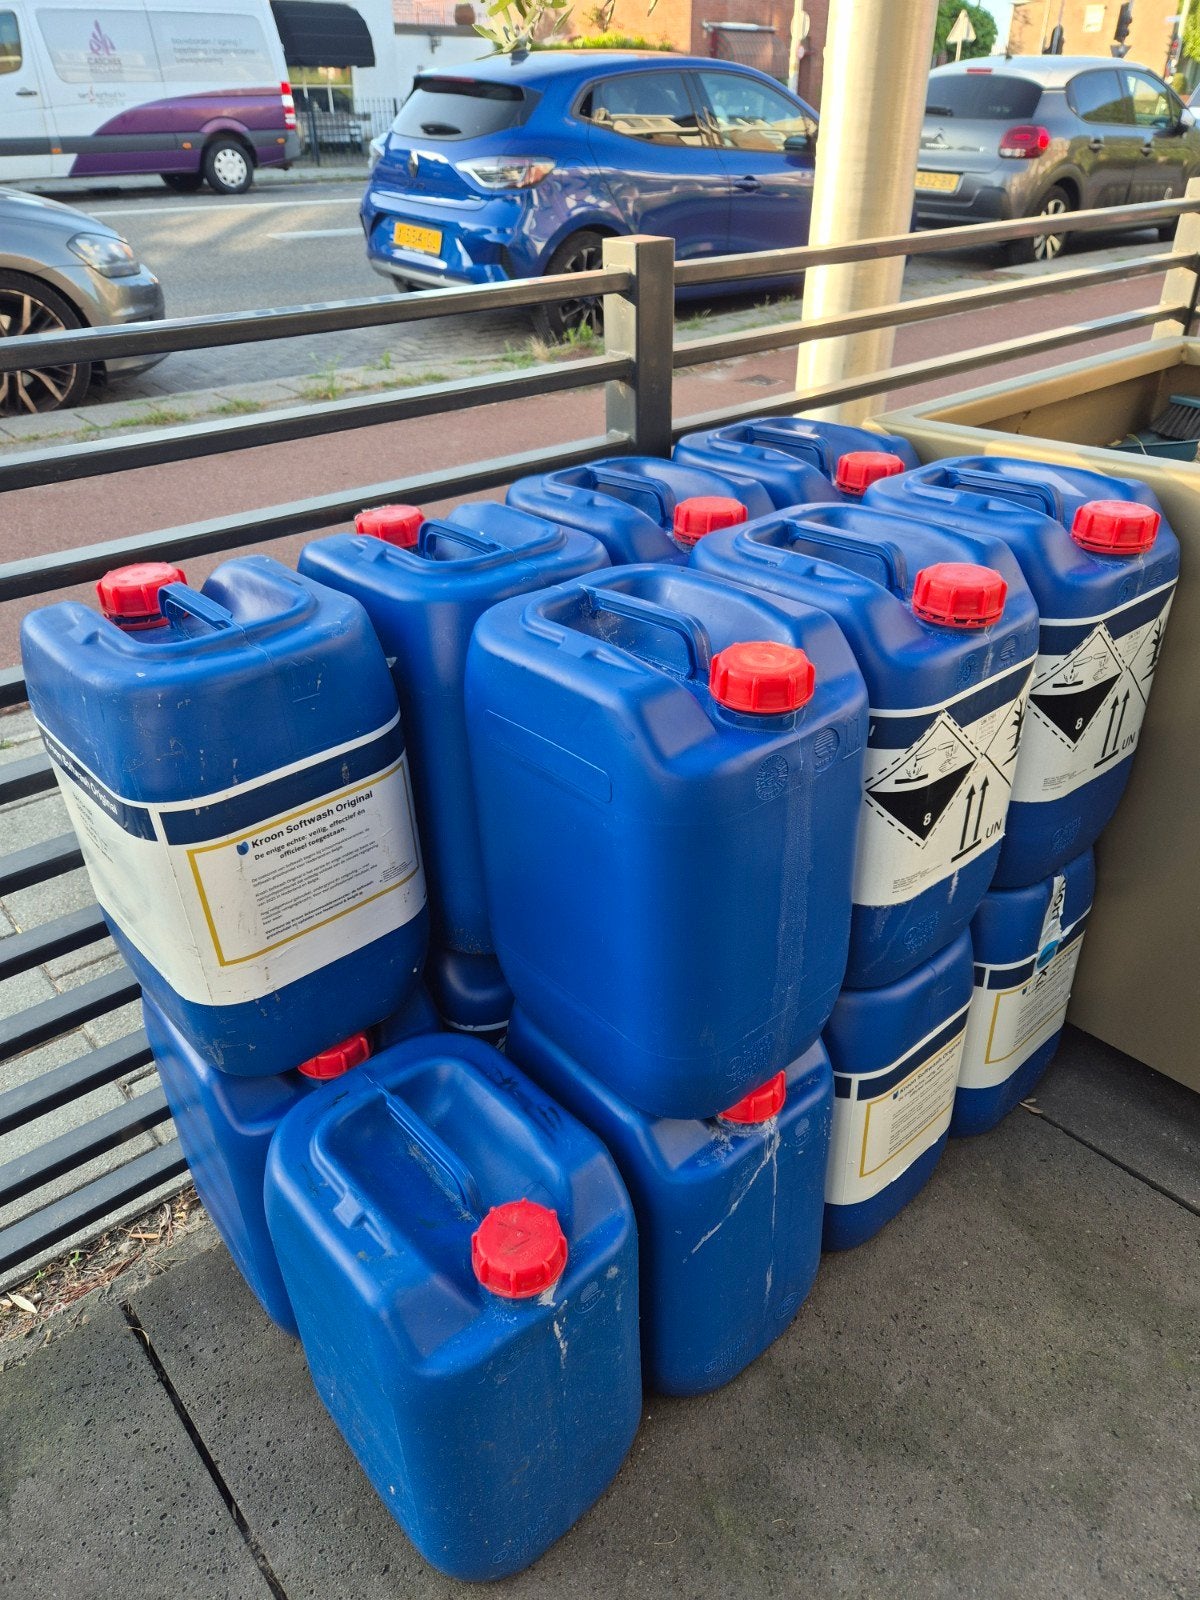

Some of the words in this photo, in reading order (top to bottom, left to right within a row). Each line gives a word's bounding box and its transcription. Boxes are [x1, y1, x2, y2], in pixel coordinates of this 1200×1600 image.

[1075, 717, 1083, 730] 8
[1121, 731, 1137, 750] UN
[251, 826, 284, 849] Kroon
[286, 807, 335, 835] Softwash
[336, 790, 373, 812] Original
[923, 812, 932, 826] 8
[985, 818, 1003, 839] UN
[254, 850, 265, 861] De
[266, 843, 286, 858] enige
[286, 834, 307, 849] echte:
[329, 812, 357, 832] effectief
[279, 842, 307, 859] officieel
